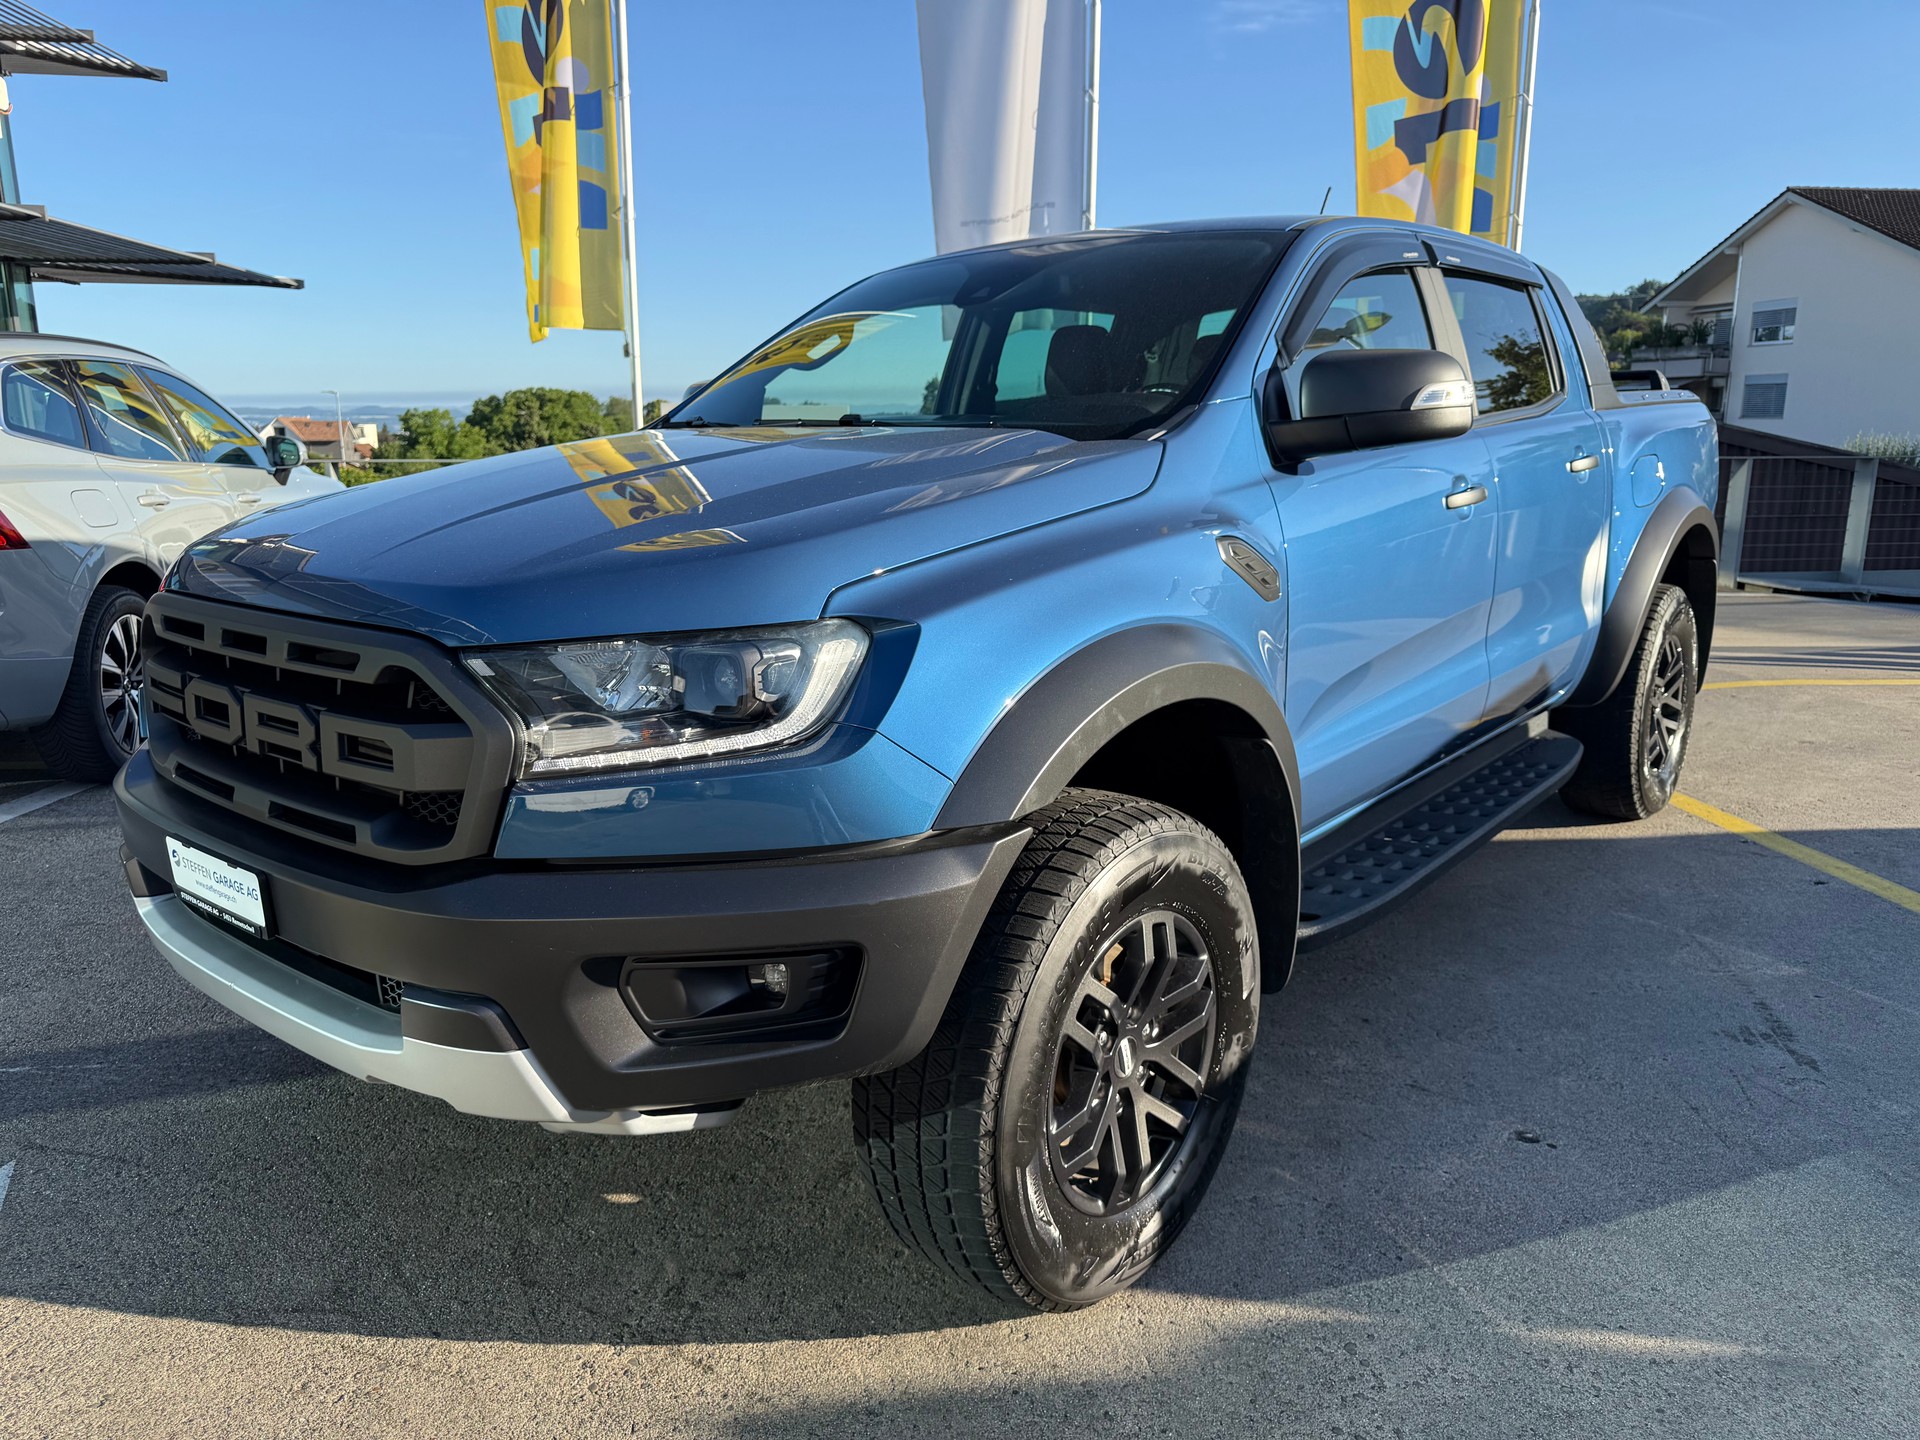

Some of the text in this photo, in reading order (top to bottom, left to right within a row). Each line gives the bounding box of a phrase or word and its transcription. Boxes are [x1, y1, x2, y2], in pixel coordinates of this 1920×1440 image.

[144, 654, 415, 790] FORD
[182, 856, 259, 901] STEFFEN GARAGE AG
[181, 892, 198, 905] STEFFEN
[197, 899, 212, 913] GARAGE
[211, 906, 219, 915] AG
